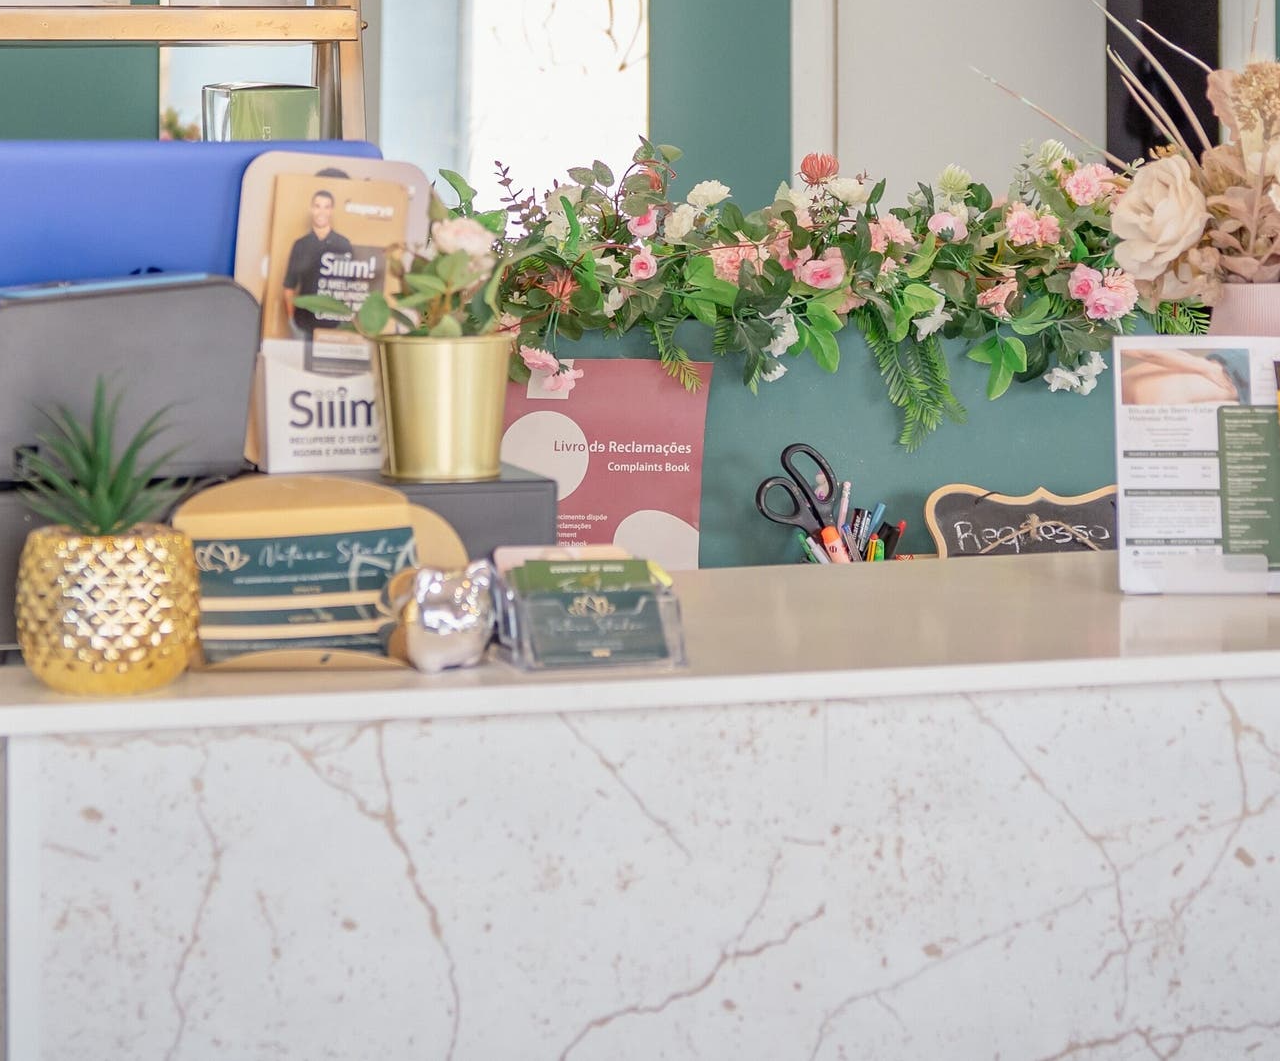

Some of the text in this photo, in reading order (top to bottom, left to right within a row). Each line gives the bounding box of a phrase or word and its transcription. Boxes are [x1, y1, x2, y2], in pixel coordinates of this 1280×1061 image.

[554, 440, 692, 456] Livro de Reclamações
[607, 462, 690, 474] Complaints Book
